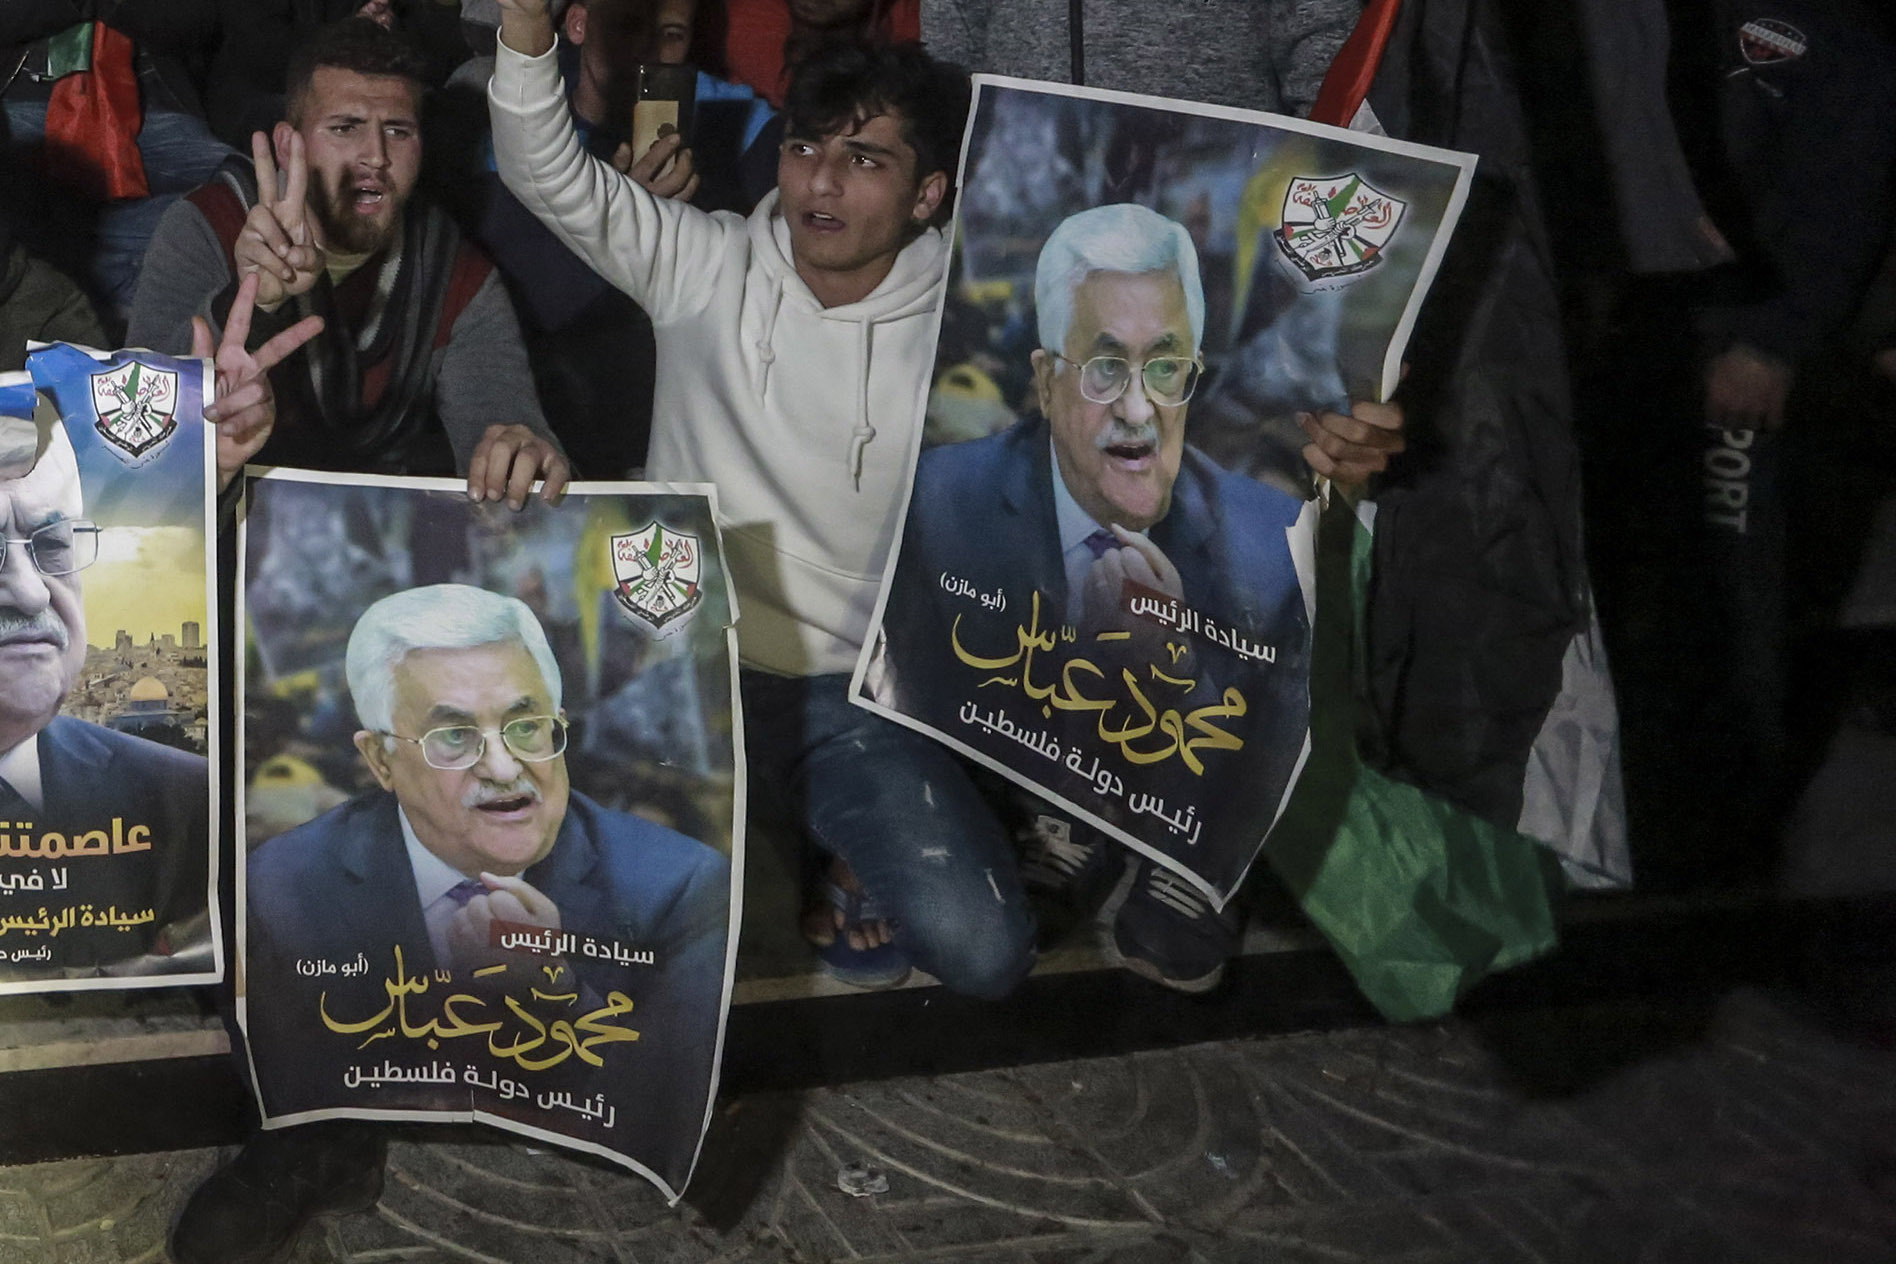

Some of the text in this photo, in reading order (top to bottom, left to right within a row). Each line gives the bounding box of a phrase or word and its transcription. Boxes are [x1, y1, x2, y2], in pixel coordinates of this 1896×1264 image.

[939, 571, 977, 599] مازن)
[1130, 593, 1278, 663] سيادة الرئيس
[959, 699, 1202, 845] رئيس دولة فلسطين
[51, 868, 68, 890] لا
[79, 905, 156, 932] سيادة
[11, 946, 52, 963] رئيس
[501, 926, 655, 965] سيادة الرئيس
[296, 957, 337, 977] مازن)
[344, 1059, 615, 1128] رئيس دولة فلسطين
